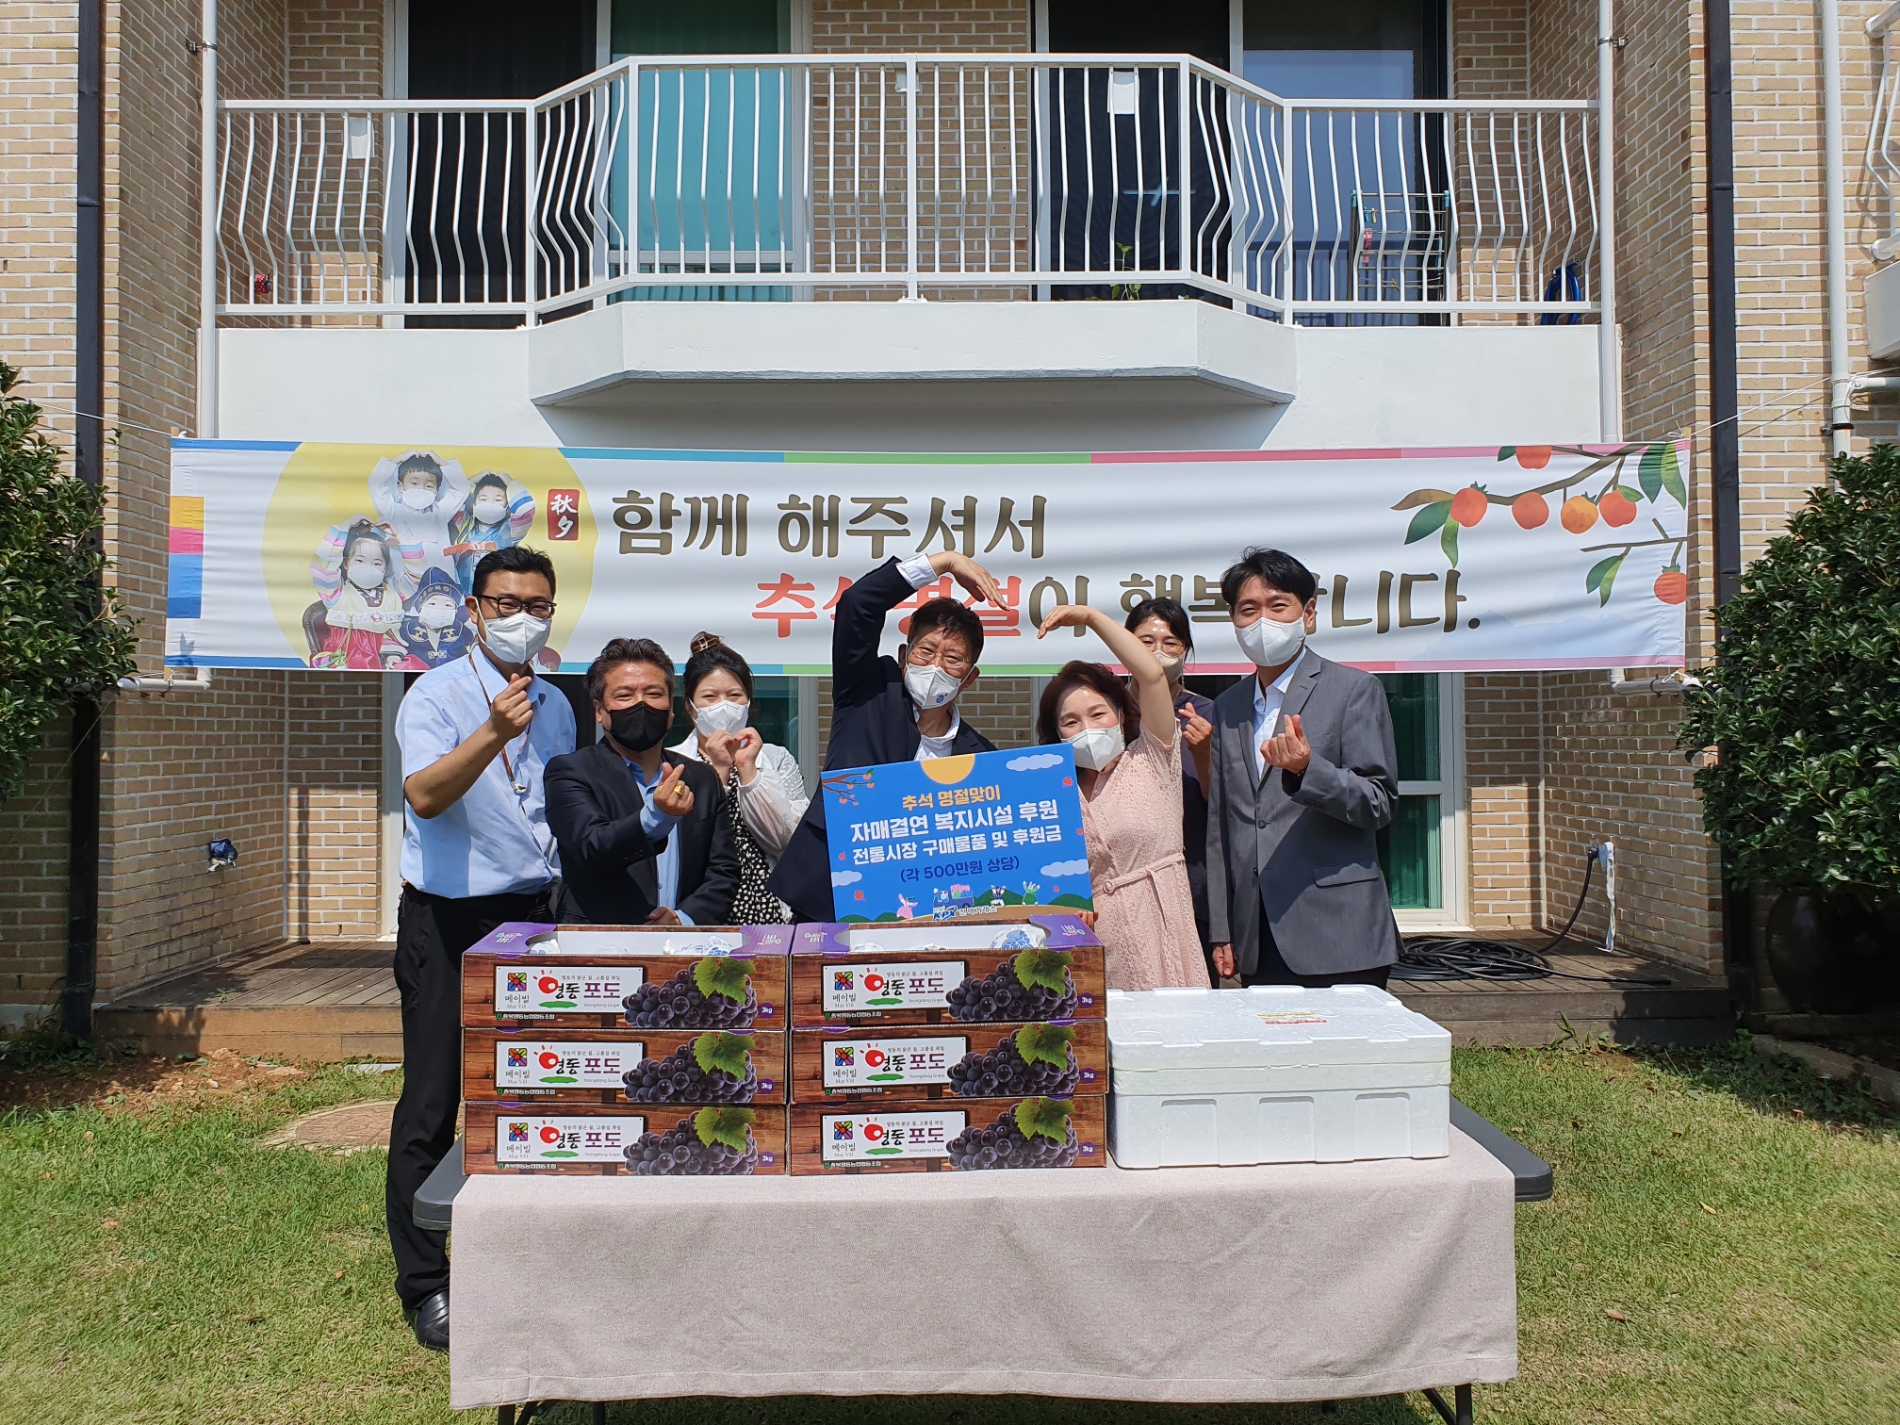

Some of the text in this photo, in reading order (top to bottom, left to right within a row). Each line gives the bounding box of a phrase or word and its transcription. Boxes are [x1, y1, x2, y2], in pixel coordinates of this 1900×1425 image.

[550, 493, 578, 538] 秋夕
[612, 489, 1047, 560] 함께 해주셔서
[751, 568, 1481, 638] 추절이 행복니다.
[902, 784, 1001, 811] 추석 명절맞이
[850, 799, 1059, 843] 자매결연 복지시설 후원
[852, 825, 1063, 865] 전통시장 구매물품 및 후원금
[900, 855, 1020, 883] (각 500만원 상당)
[933, 906, 958, 920] KPX
[538, 976, 620, 999] 영동 포도
[864, 974, 944, 996] 영동 포도
[505, 995, 529, 1003] 메이빌
[833, 993, 856, 1002] 메이빌
[539, 1052, 620, 1074] 영동 포도
[865, 1050, 945, 1072] 영동 포도
[506, 1070, 529, 1078] 메이빌
[833, 1069, 856, 1078] 메이빌
[540, 1126, 621, 1149] 영동 포도
[864, 1124, 944, 1146] 영동 포도
[507, 1144, 530, 1153] 메이빌
[832, 1143, 855, 1151] 메이빌
